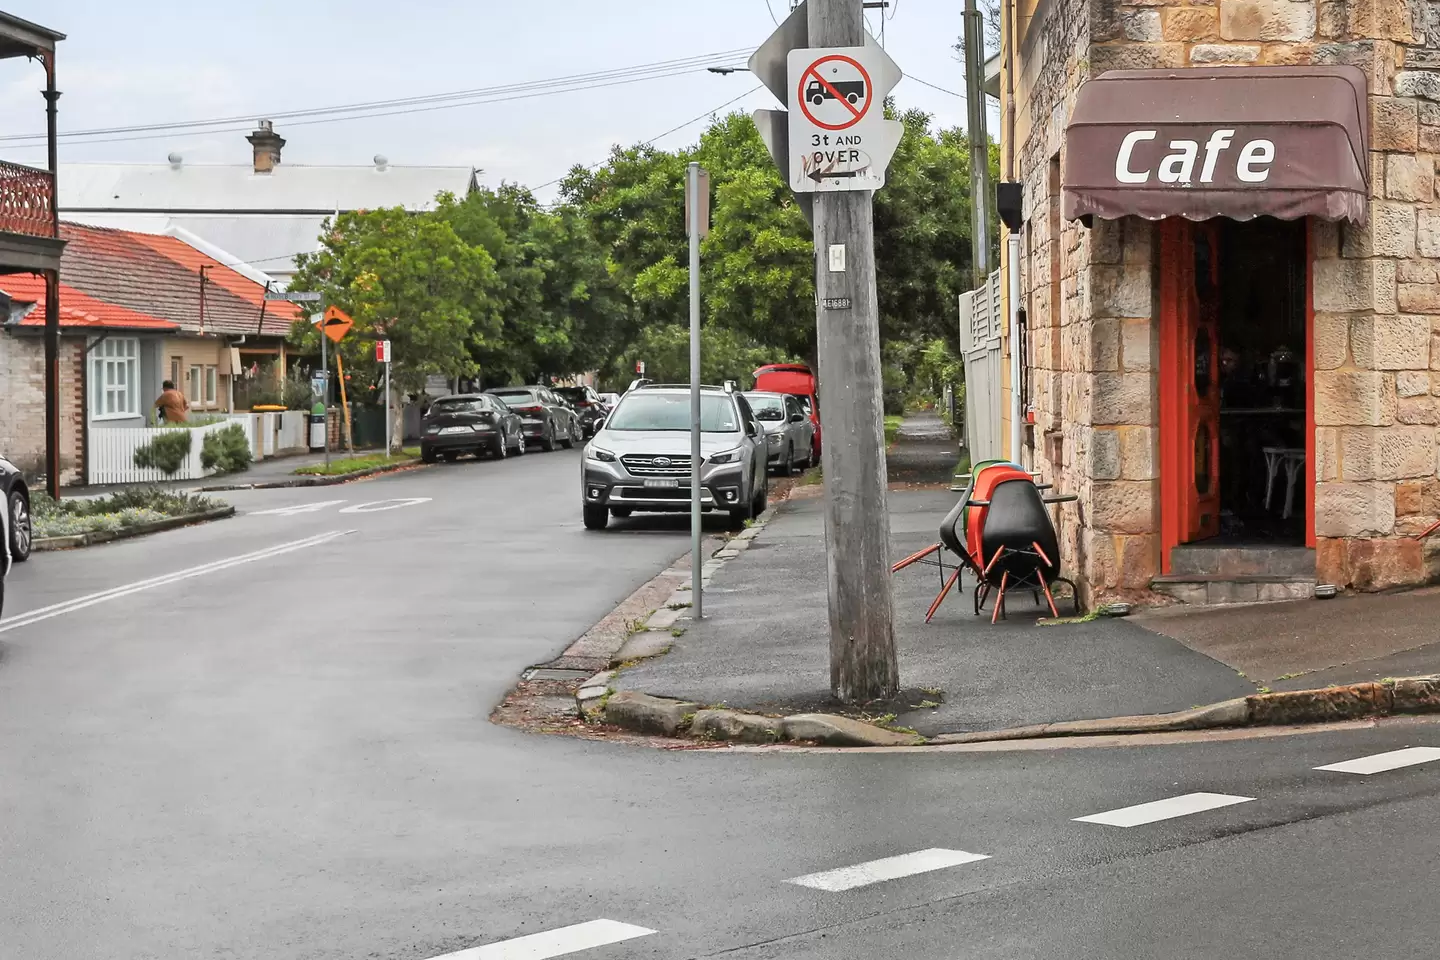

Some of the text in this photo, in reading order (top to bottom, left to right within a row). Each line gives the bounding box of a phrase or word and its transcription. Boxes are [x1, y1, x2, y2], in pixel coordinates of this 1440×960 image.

[811, 134, 862, 147] 3t AND
[813, 150, 860, 163] OVER
[1115, 129, 1276, 184] Cafe
